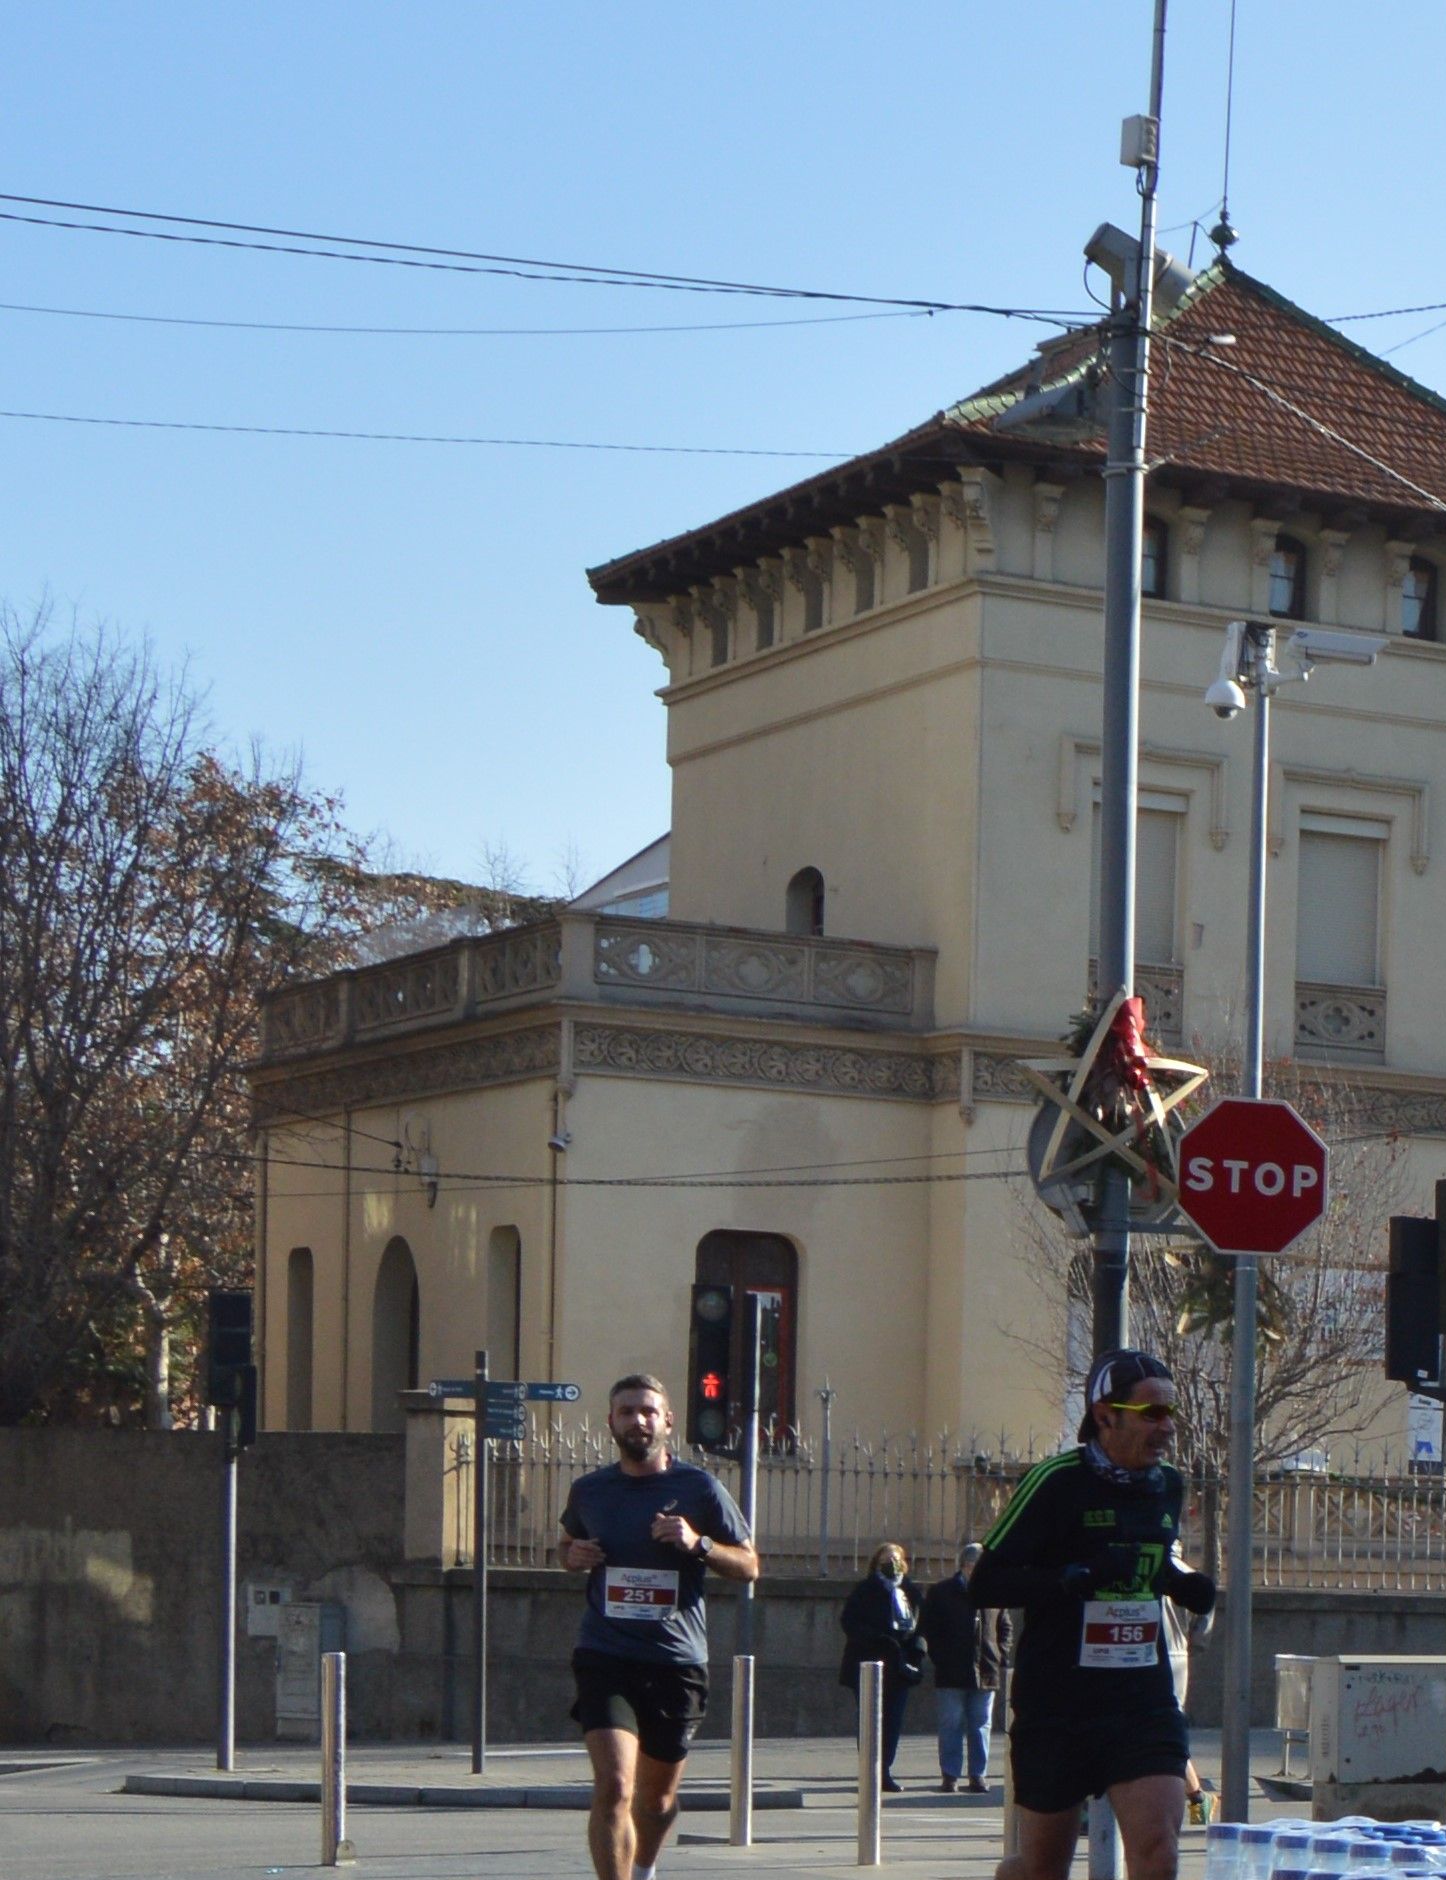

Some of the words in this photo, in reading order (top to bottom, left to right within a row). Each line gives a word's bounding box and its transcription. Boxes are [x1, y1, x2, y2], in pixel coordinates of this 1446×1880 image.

[1185, 1156, 1319, 1198] STOP
[623, 1589, 655, 1603] 251
[1109, 1625, 1144, 1642] 156
